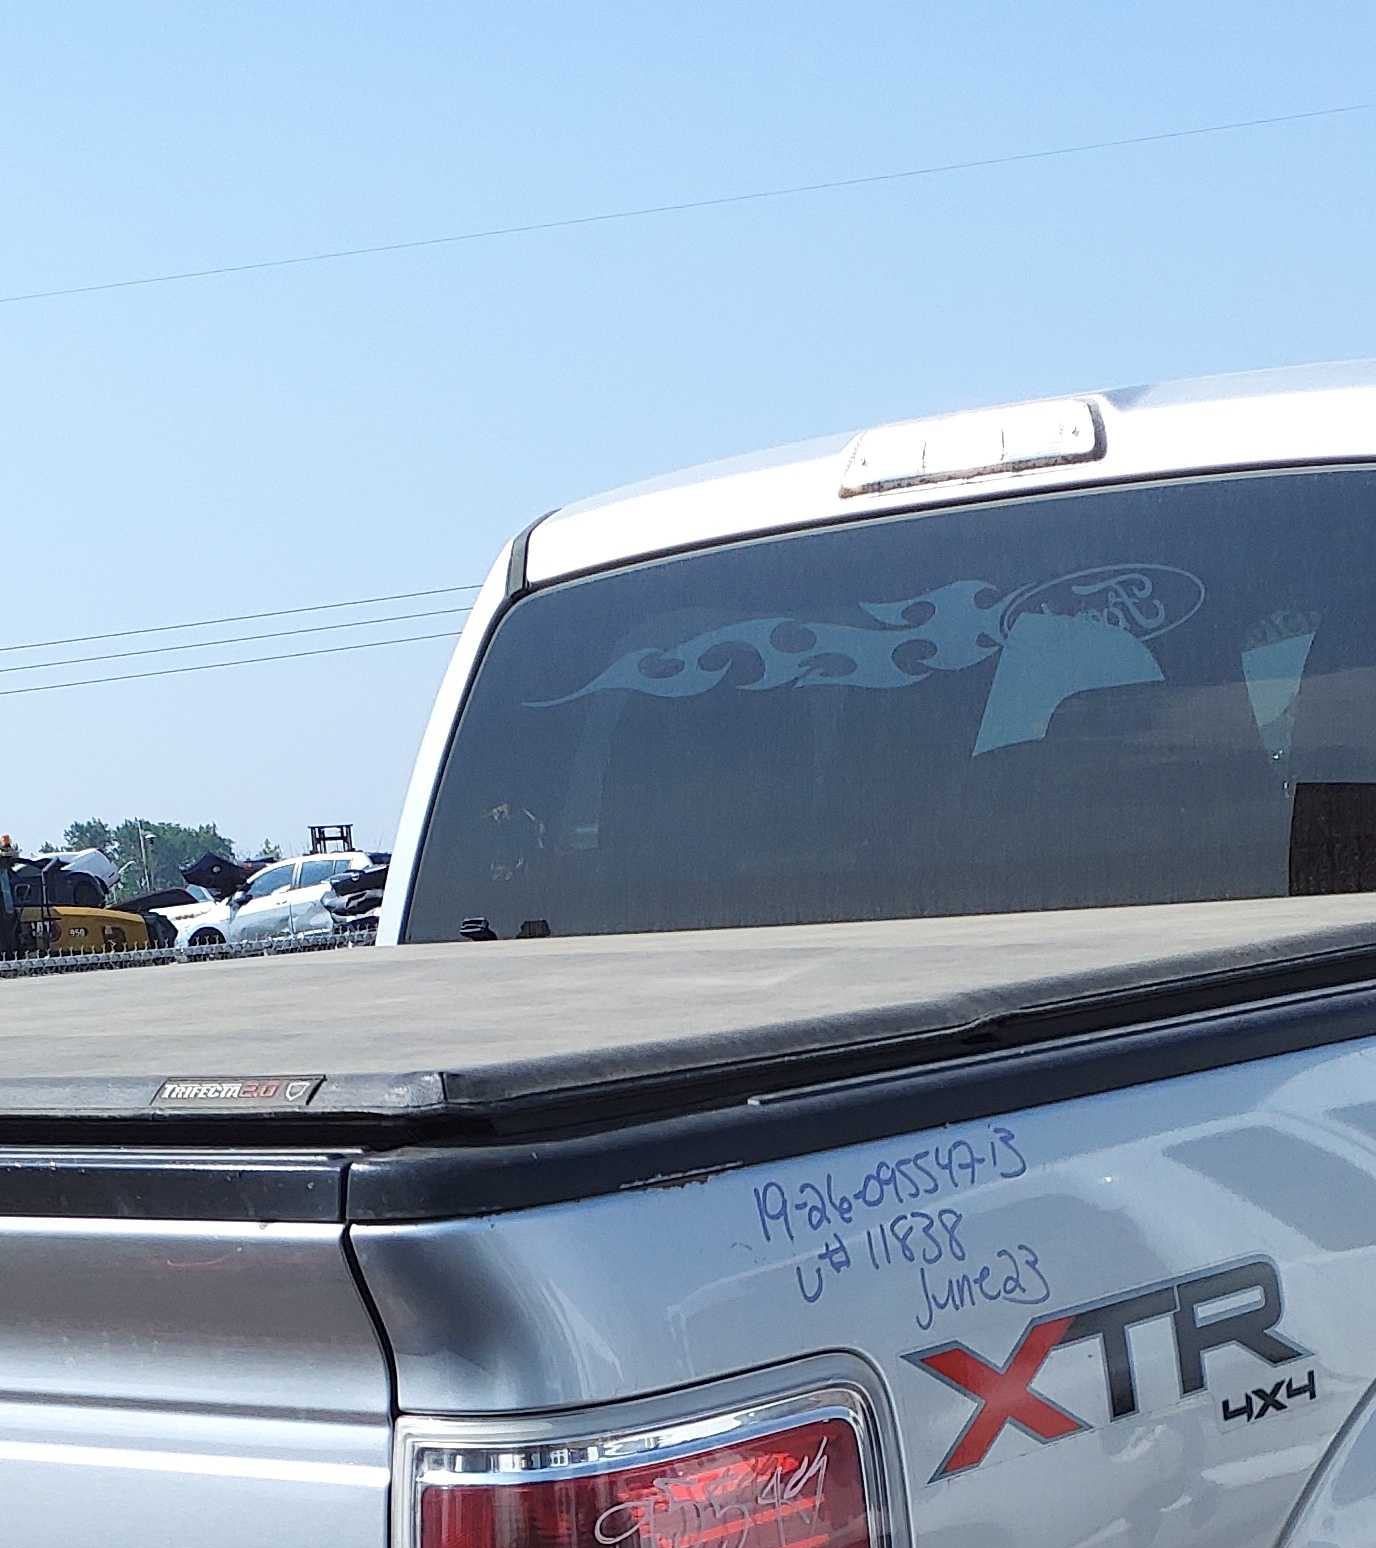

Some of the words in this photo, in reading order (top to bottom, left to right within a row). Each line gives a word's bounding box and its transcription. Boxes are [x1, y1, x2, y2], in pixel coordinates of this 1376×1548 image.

[160, 1082, 242, 1099] TRIFECTA
[239, 1079, 281, 1099] 2.0
[865, 1207, 967, 1270] 11838
[899, 1252, 1316, 1489] XTR
